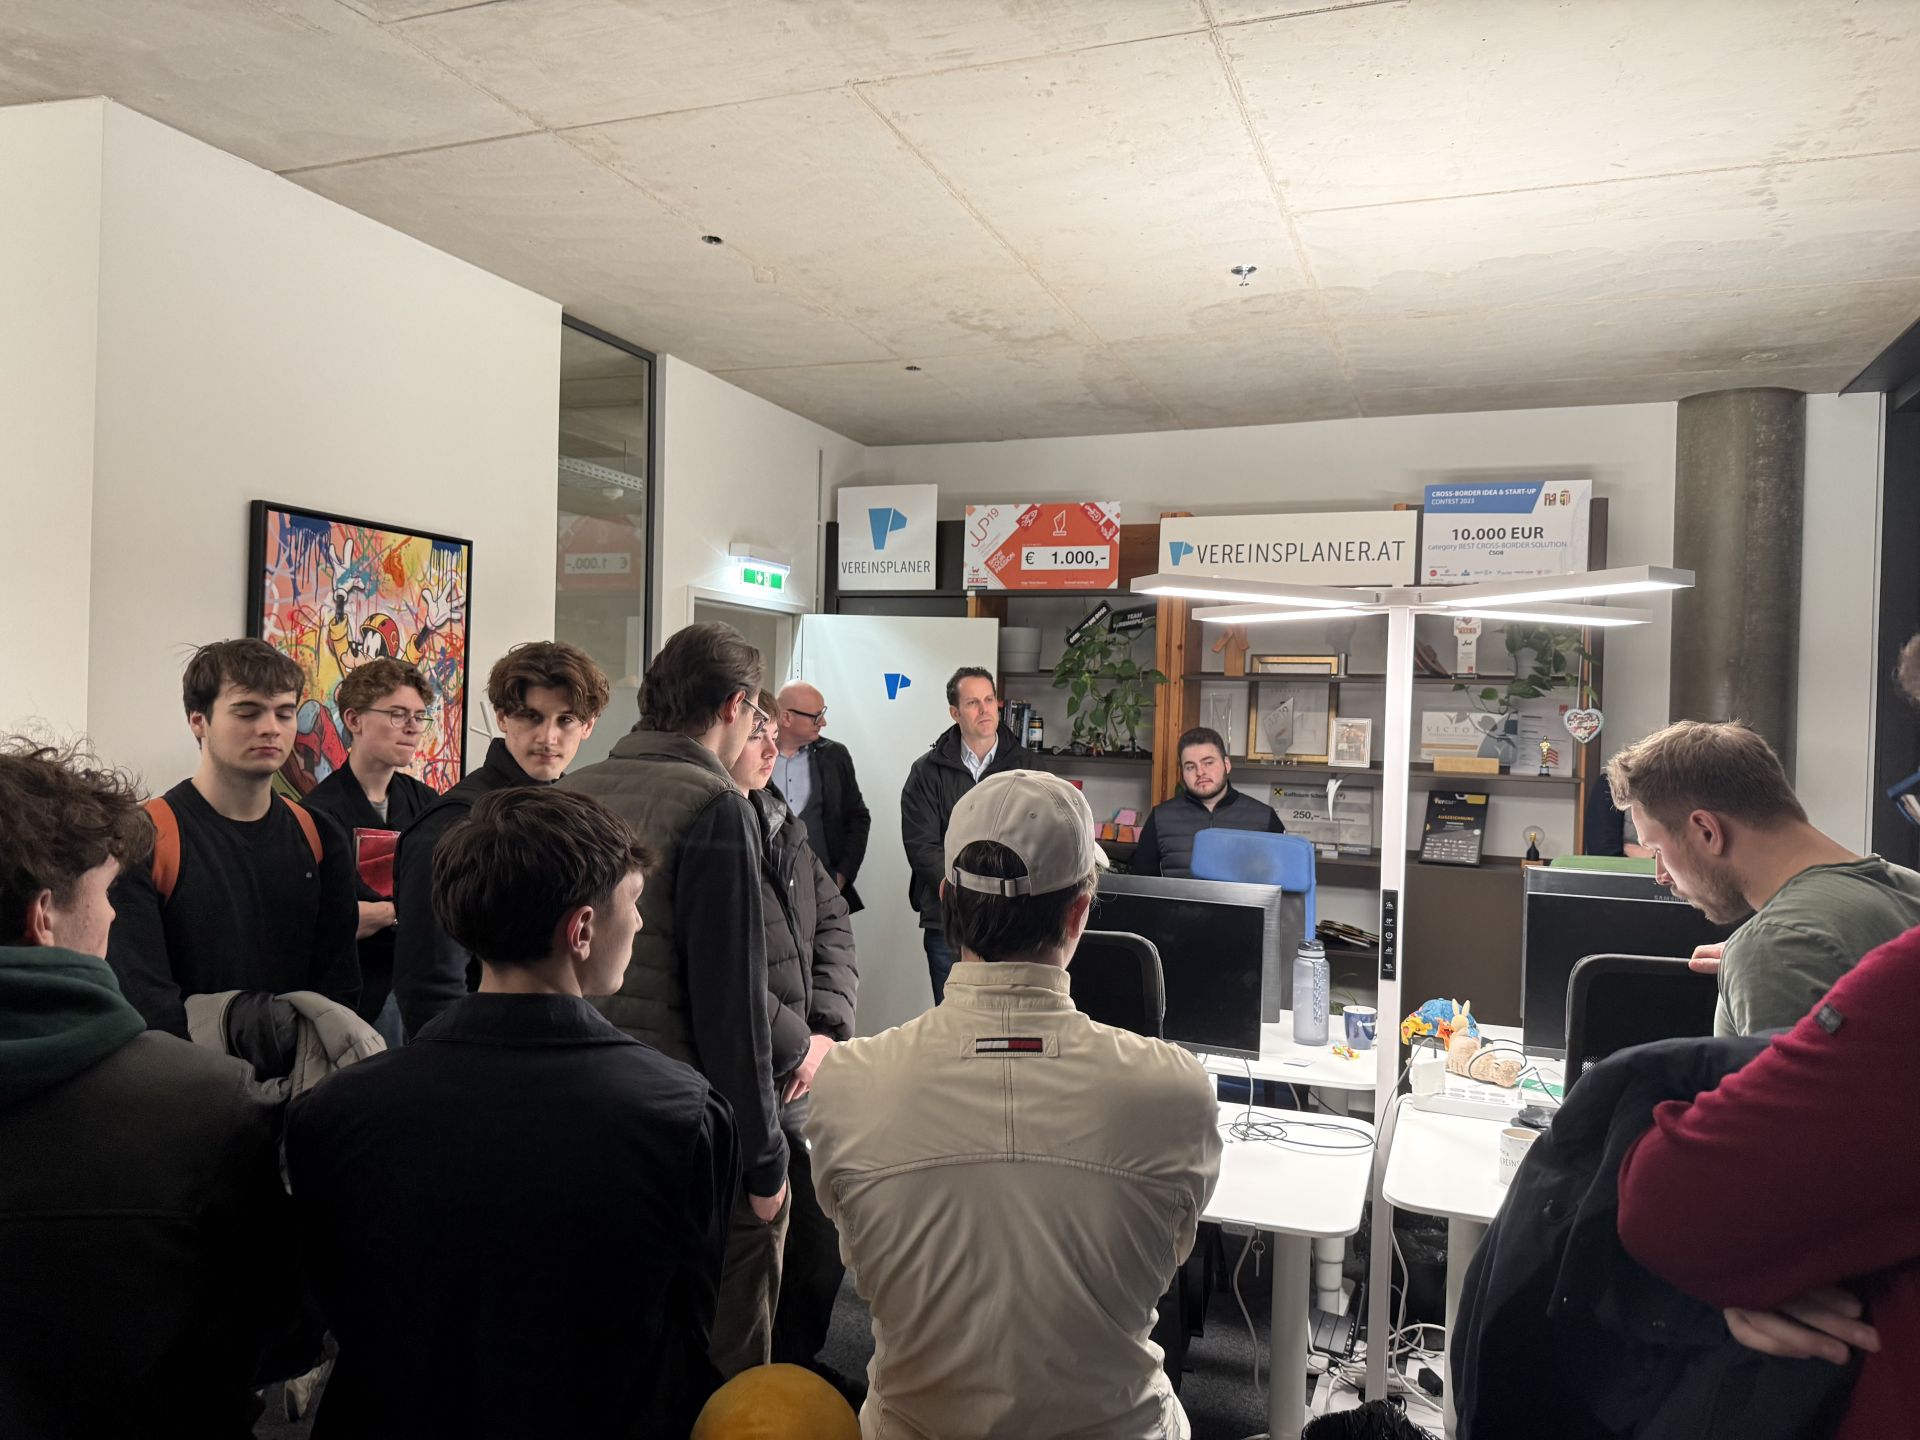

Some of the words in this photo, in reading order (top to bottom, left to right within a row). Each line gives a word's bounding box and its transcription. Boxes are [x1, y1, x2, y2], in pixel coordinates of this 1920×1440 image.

[1452, 528, 1506, 541] 10.000
[1511, 526, 1544, 539] EUR
[1026, 552, 1035, 564] €
[1052, 550, 1106, 566] 1.000,-
[1196, 541, 1406, 564] VEREINSPLANER.AT
[842, 560, 930, 574] VEREINSPLANER
